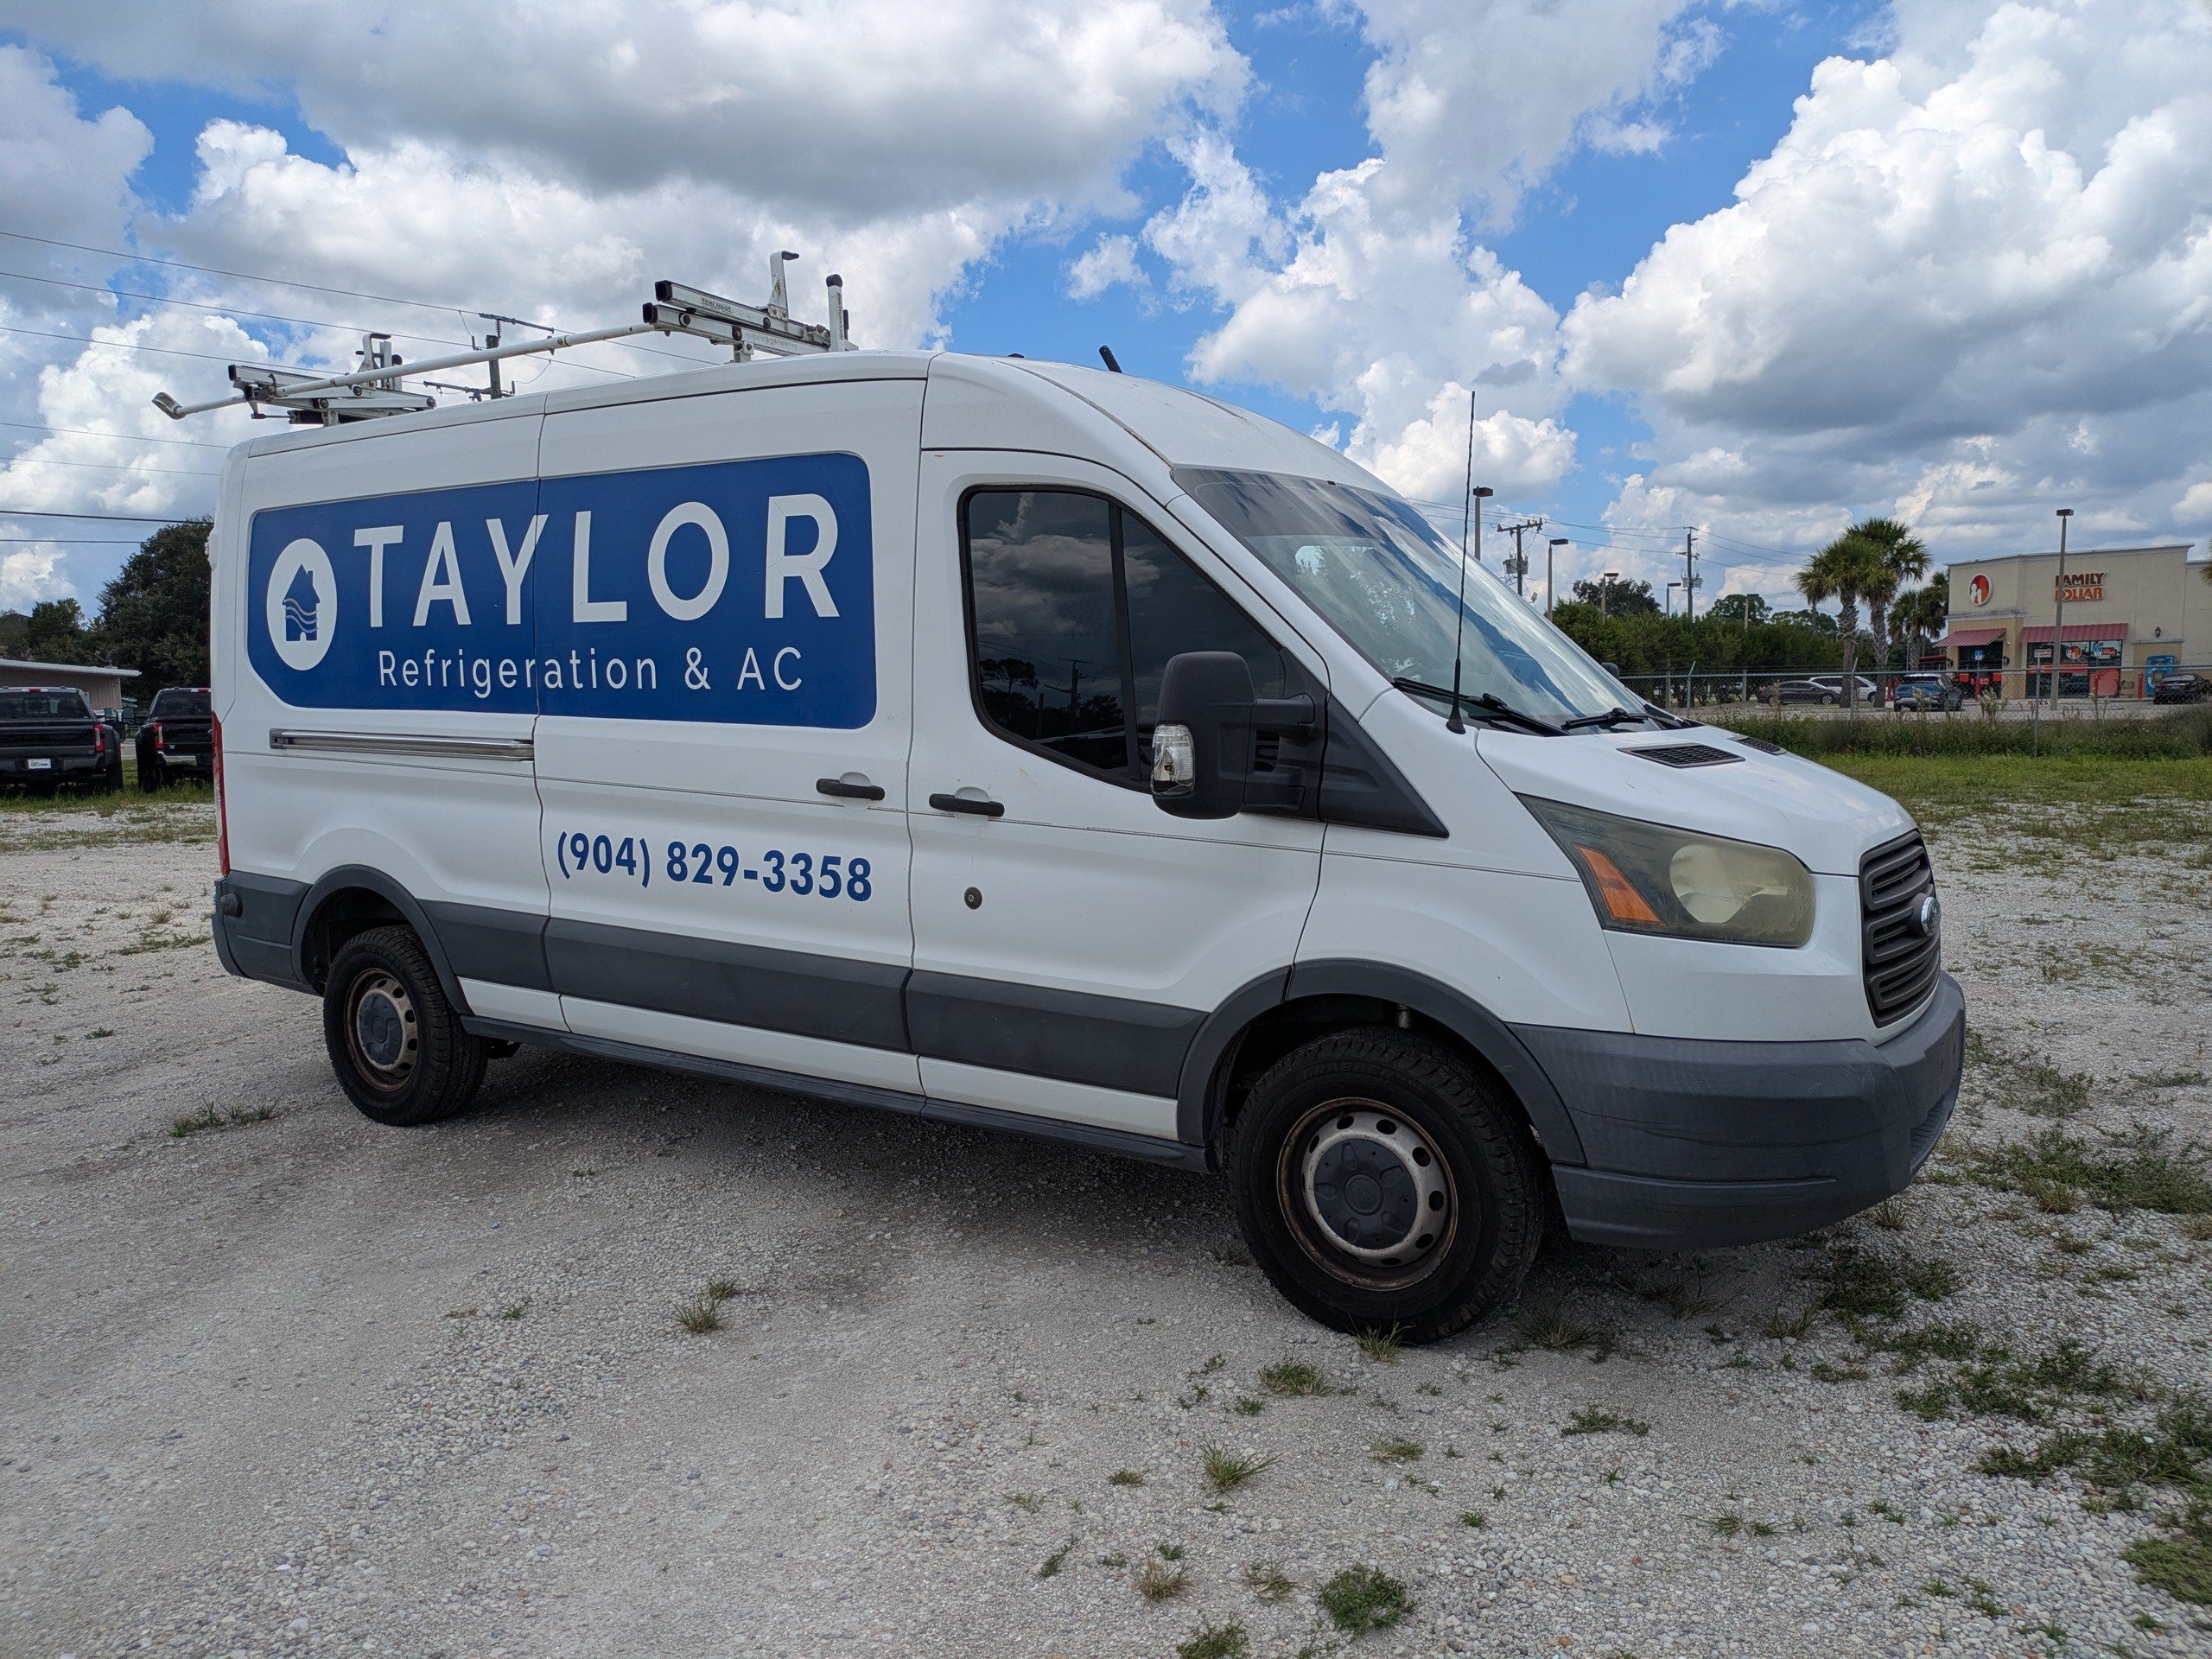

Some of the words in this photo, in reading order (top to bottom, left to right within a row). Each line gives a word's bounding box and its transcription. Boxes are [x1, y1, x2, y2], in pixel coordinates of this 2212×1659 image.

[354, 493, 840, 627] TAYLOR
[378, 648, 658, 698] Refrigeration
[684, 647, 711, 690] &
[737, 646, 803, 690] AC
[557, 830, 651, 888] (904)
[666, 841, 873, 902] 829-3358
